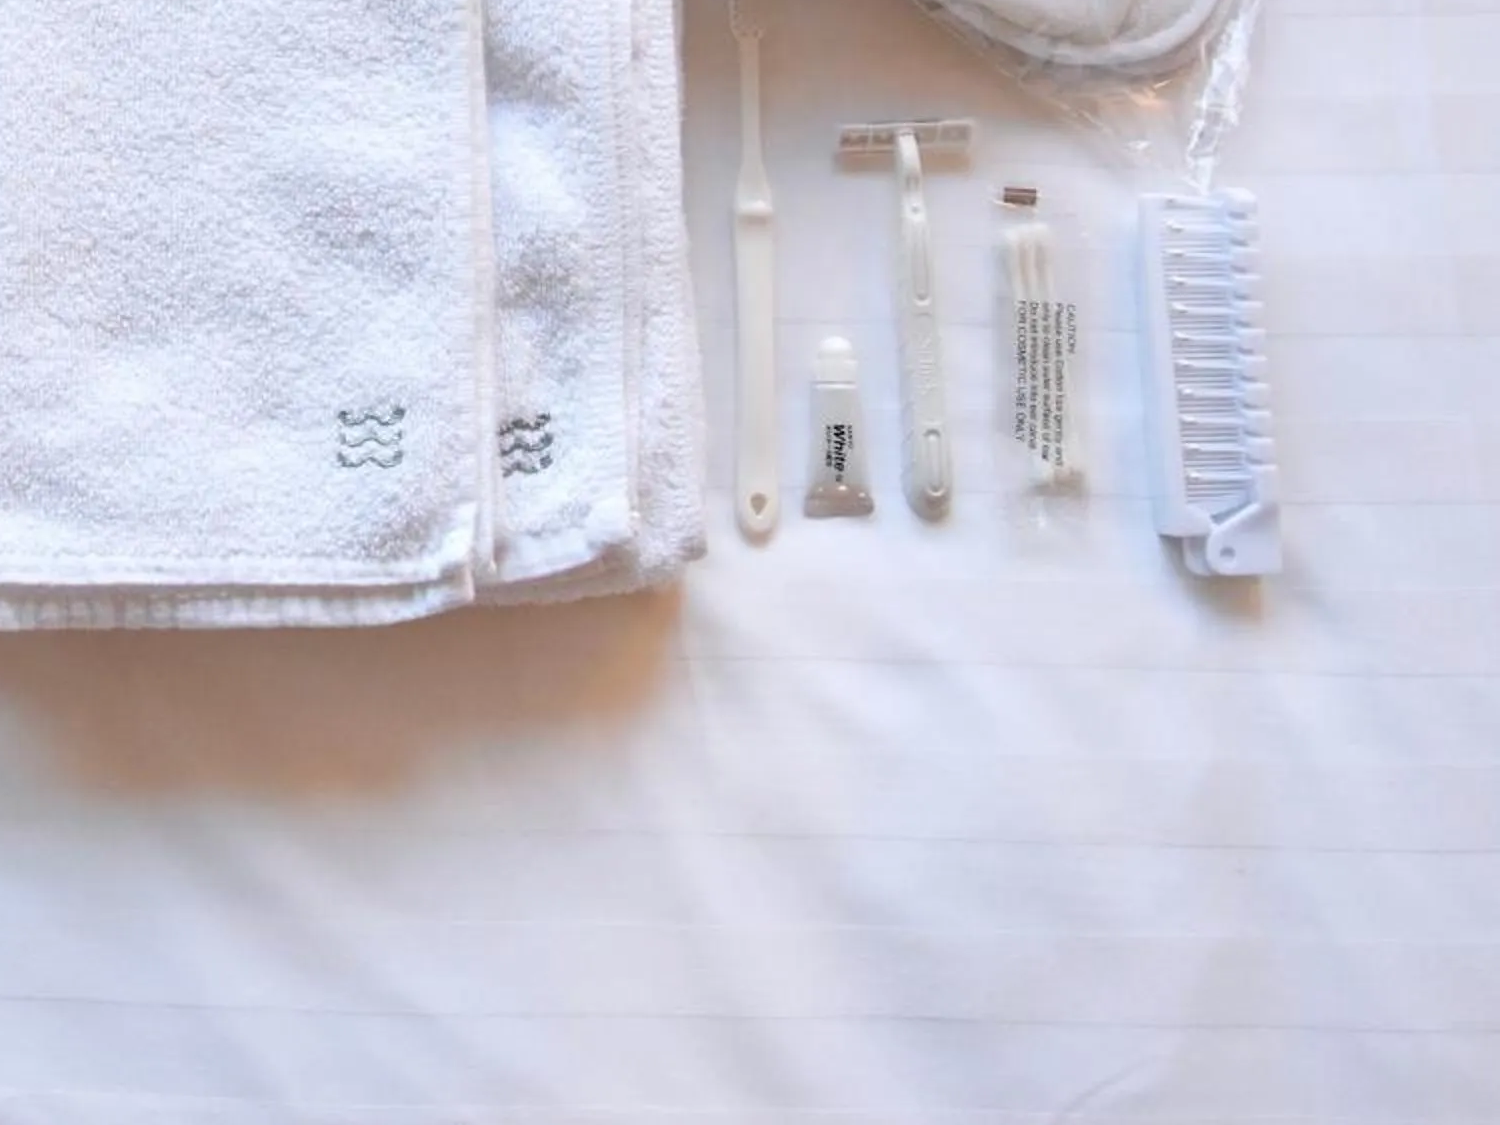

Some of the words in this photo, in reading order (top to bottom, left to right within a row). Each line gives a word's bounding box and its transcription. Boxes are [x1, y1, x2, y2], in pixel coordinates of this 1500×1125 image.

[1017, 301, 1028, 324] FOR
[1016, 326, 1027, 384] COSMETIC
[1016, 387, 1026, 408] USE
[1015, 412, 1027, 442] ONLY
[833, 425, 846, 472] White
